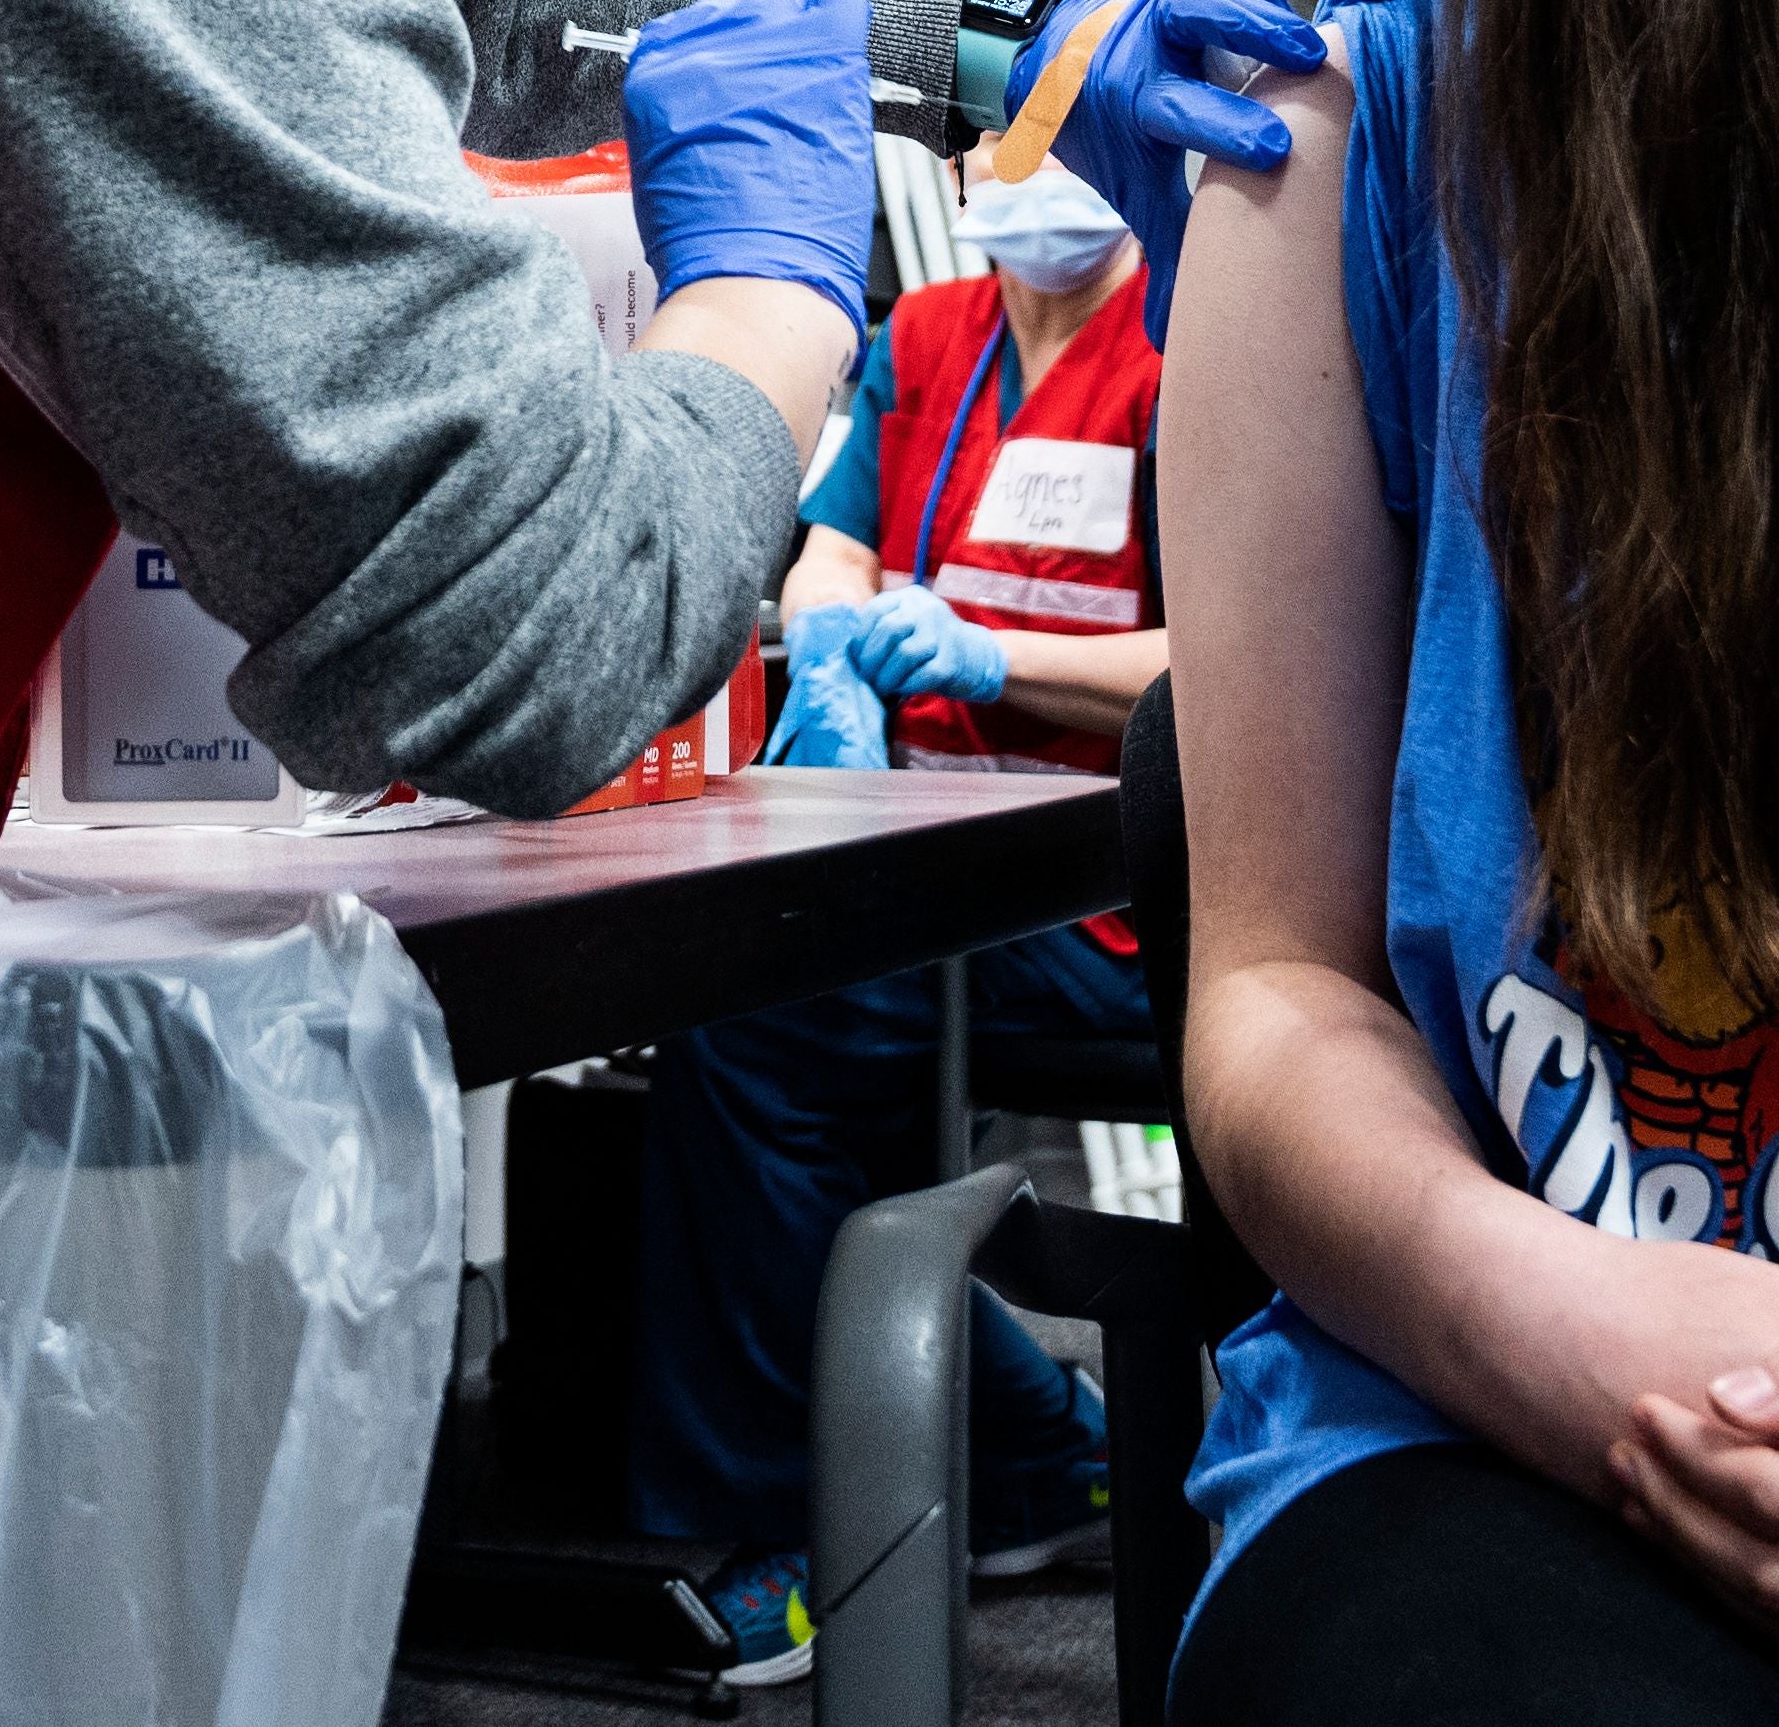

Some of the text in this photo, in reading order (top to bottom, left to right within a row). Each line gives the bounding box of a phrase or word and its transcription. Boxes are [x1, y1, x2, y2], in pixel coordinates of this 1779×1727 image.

[625, 270, 636, 318] become
[990, 454, 1085, 518] Agnes
[232, 739, 250, 761] II
[643, 741, 691, 763] MD 200
[1485, 973, 1713, 1242] The
